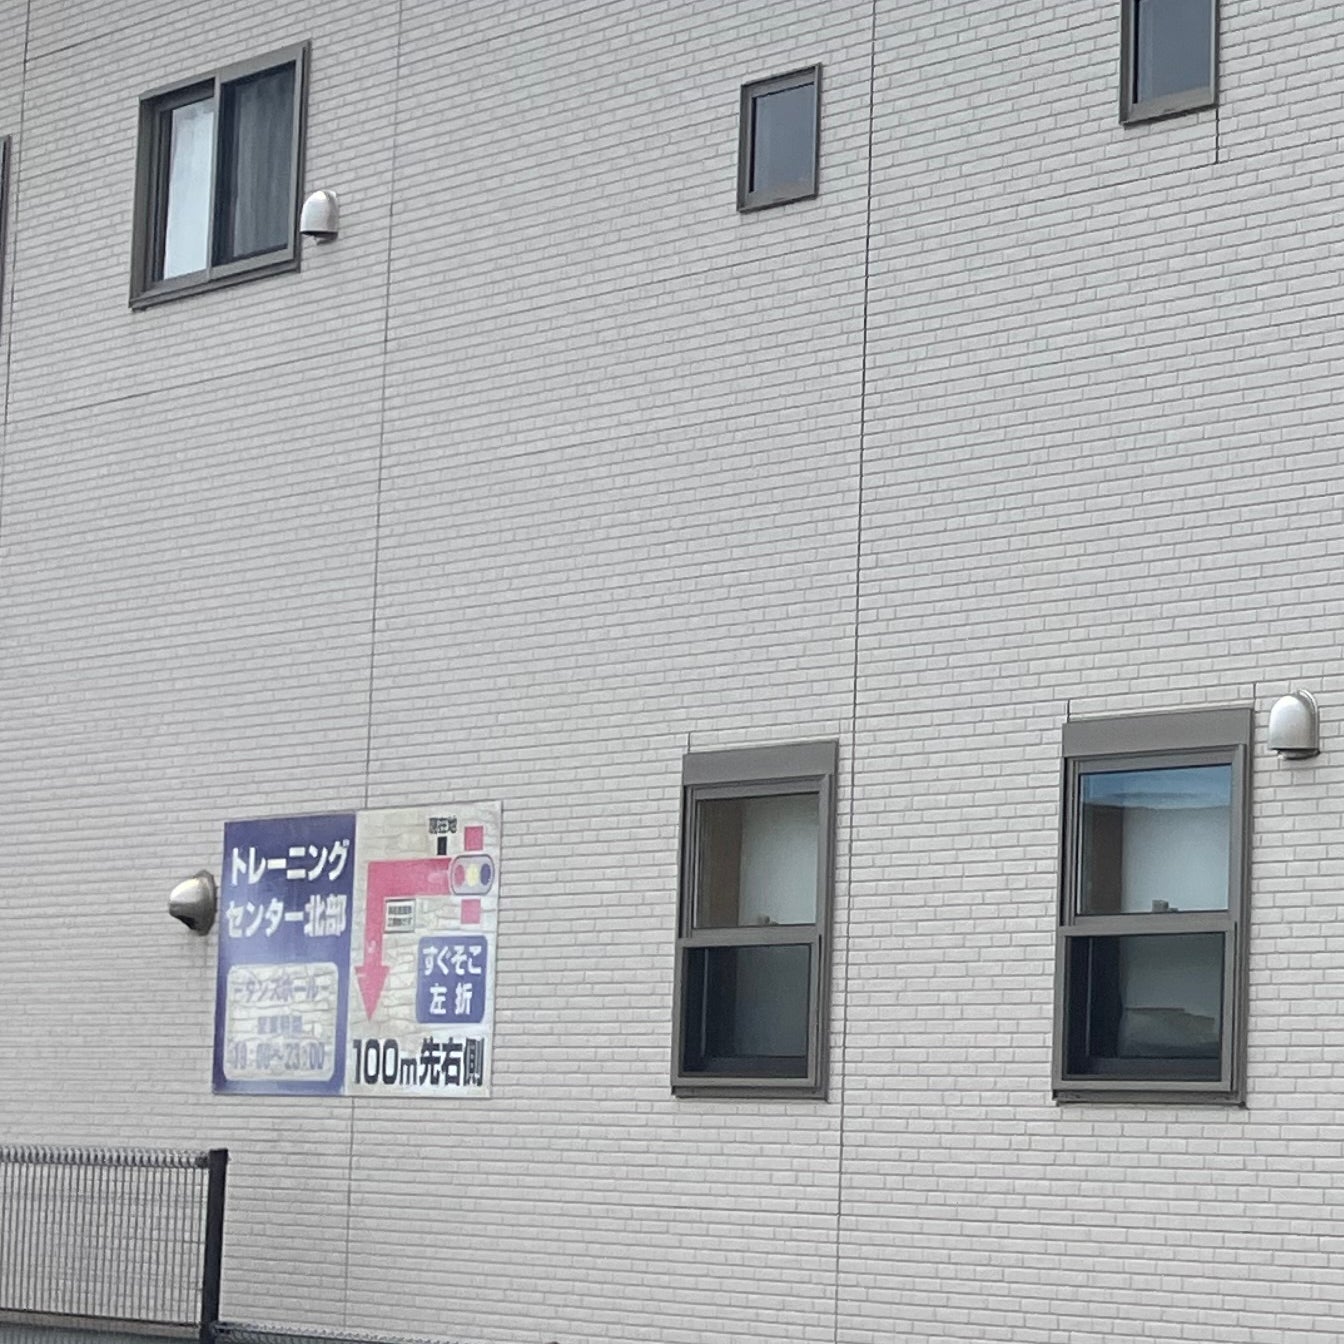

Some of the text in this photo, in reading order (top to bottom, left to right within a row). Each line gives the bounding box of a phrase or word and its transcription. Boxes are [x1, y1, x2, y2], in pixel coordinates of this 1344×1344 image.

[230, 839, 350, 886] トレーニング
[226, 894, 347, 938] センター北部
[422, 945, 482, 976] すぐそこ
[353, 1037, 485, 1087] 100m先右側
